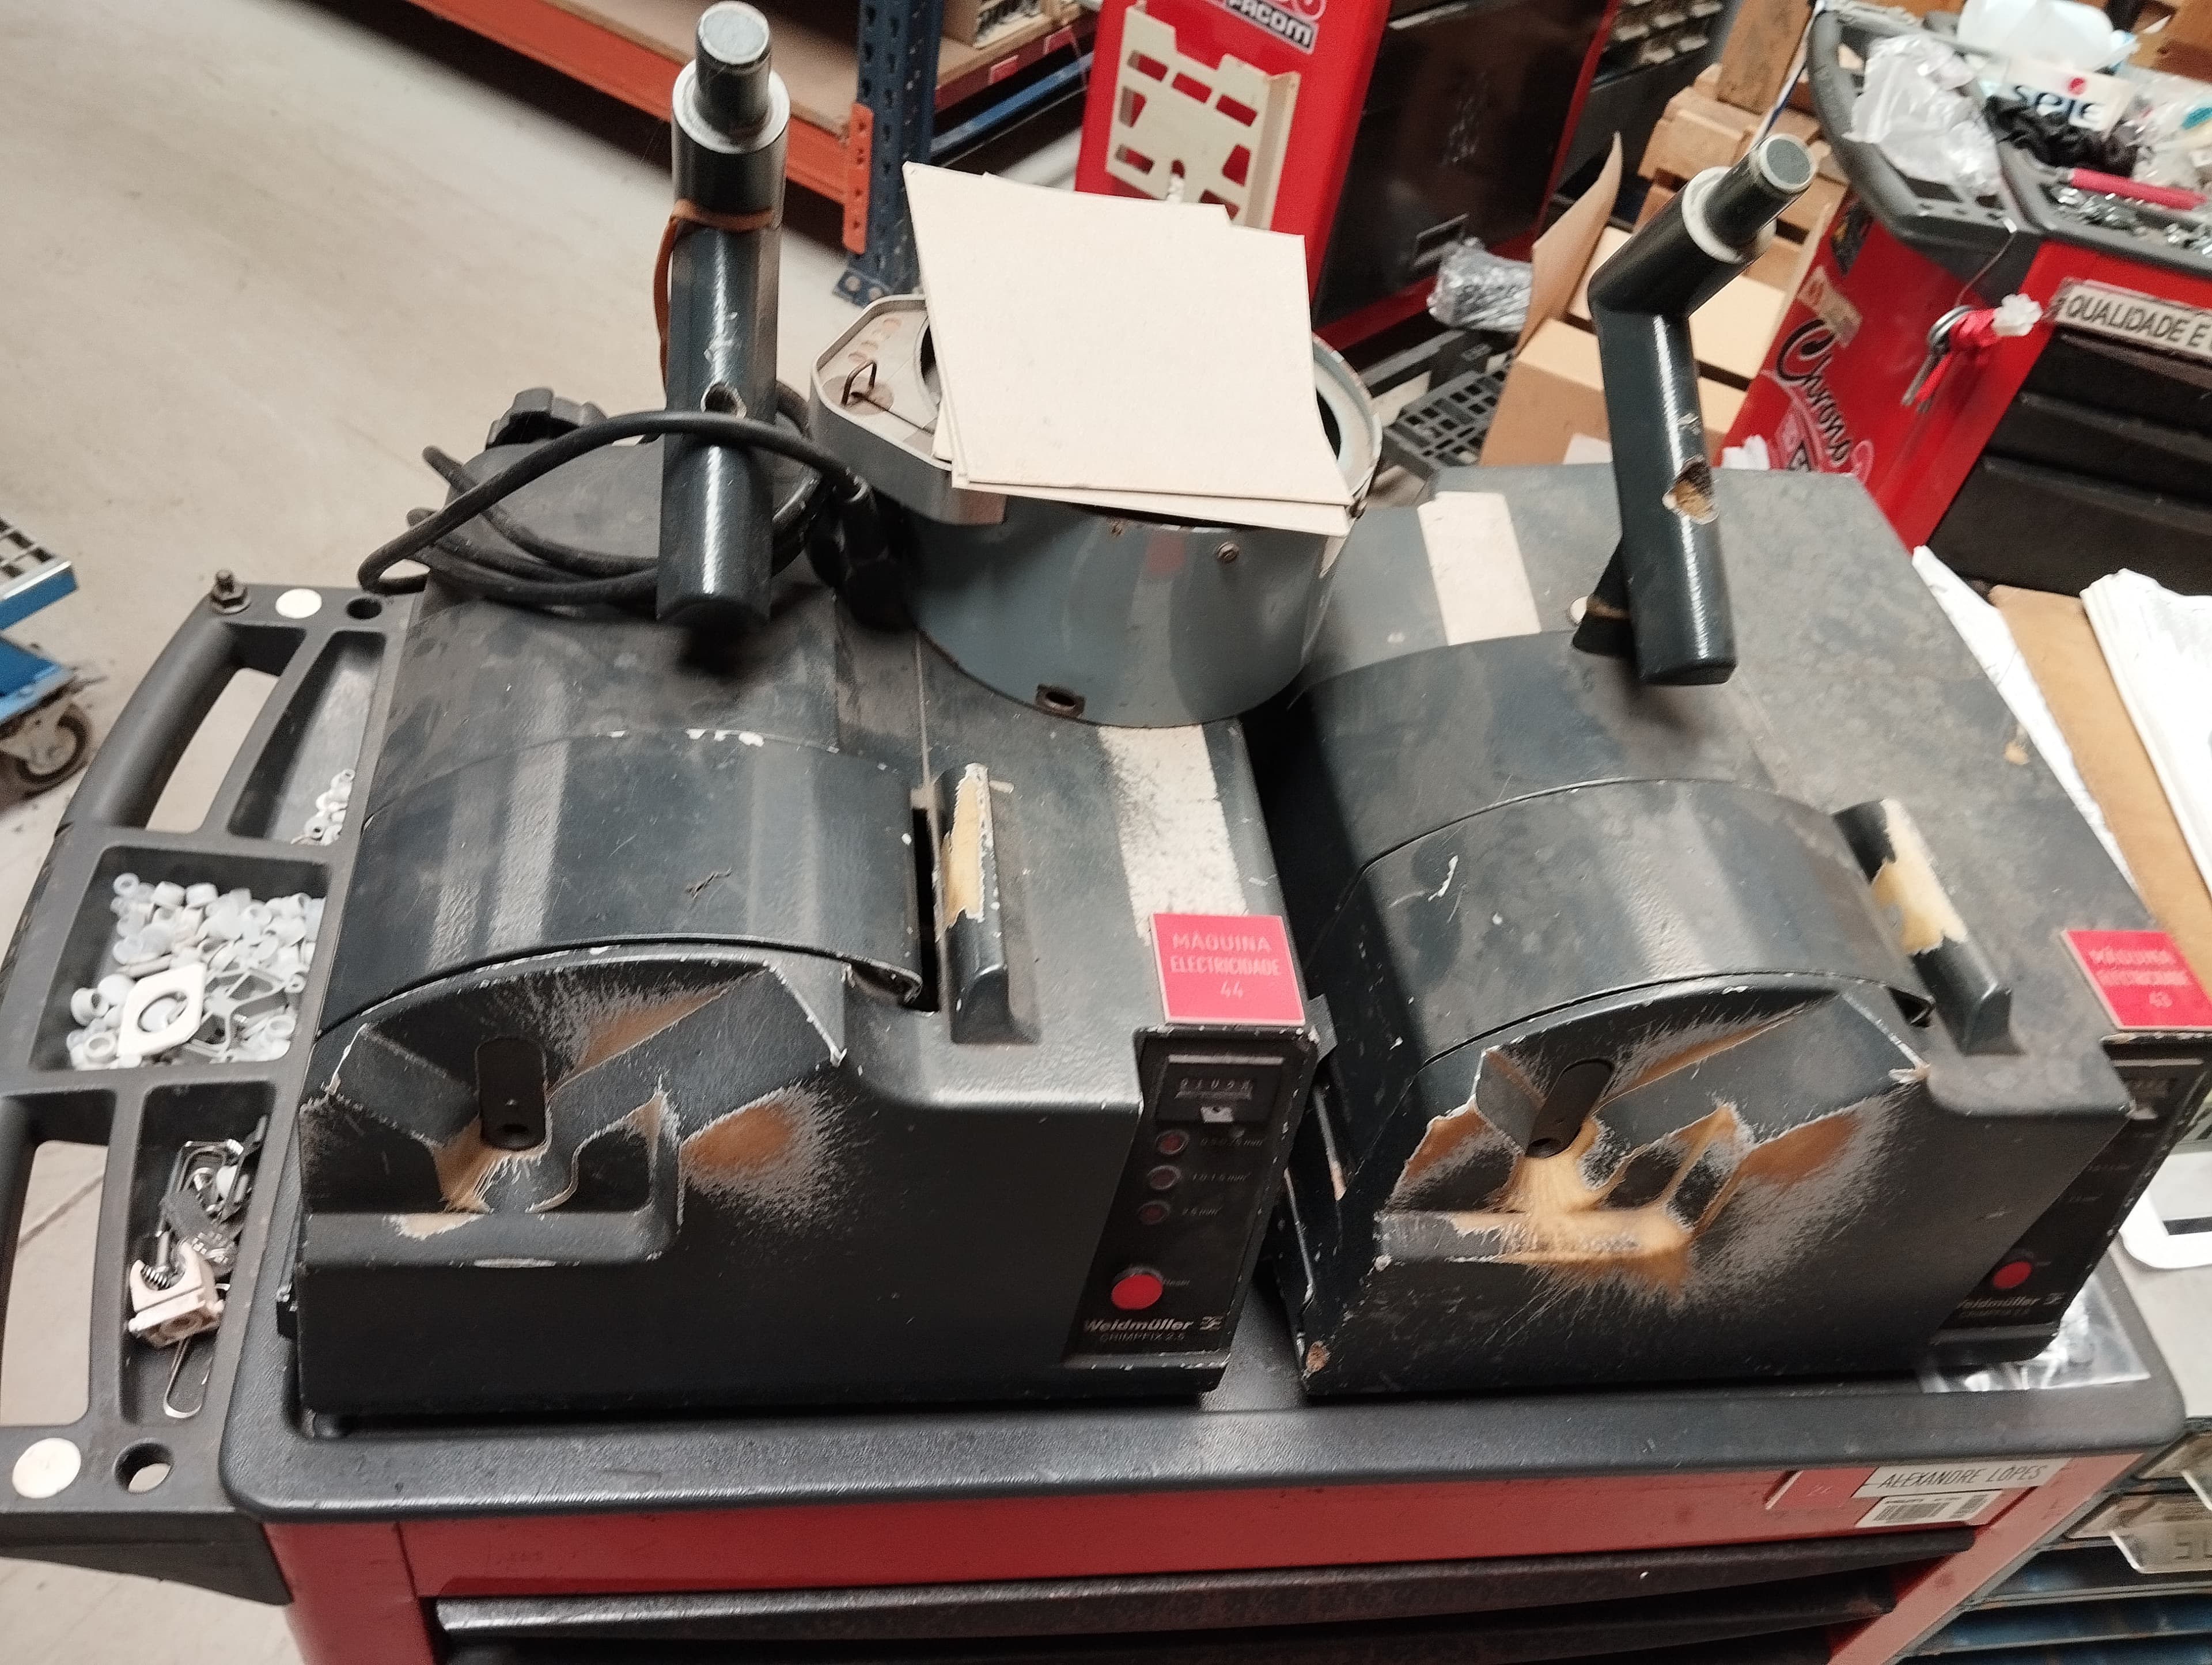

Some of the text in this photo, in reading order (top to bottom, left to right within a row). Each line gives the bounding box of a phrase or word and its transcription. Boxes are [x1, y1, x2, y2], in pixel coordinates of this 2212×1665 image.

[2066, 294, 2190, 342] QUALIDADE
[1220, 980, 1244, 999] 44
[1084, 1318, 1194, 1333] Weidmüller
[1877, 1465, 2048, 1489] ALEXANDRE LOPES
